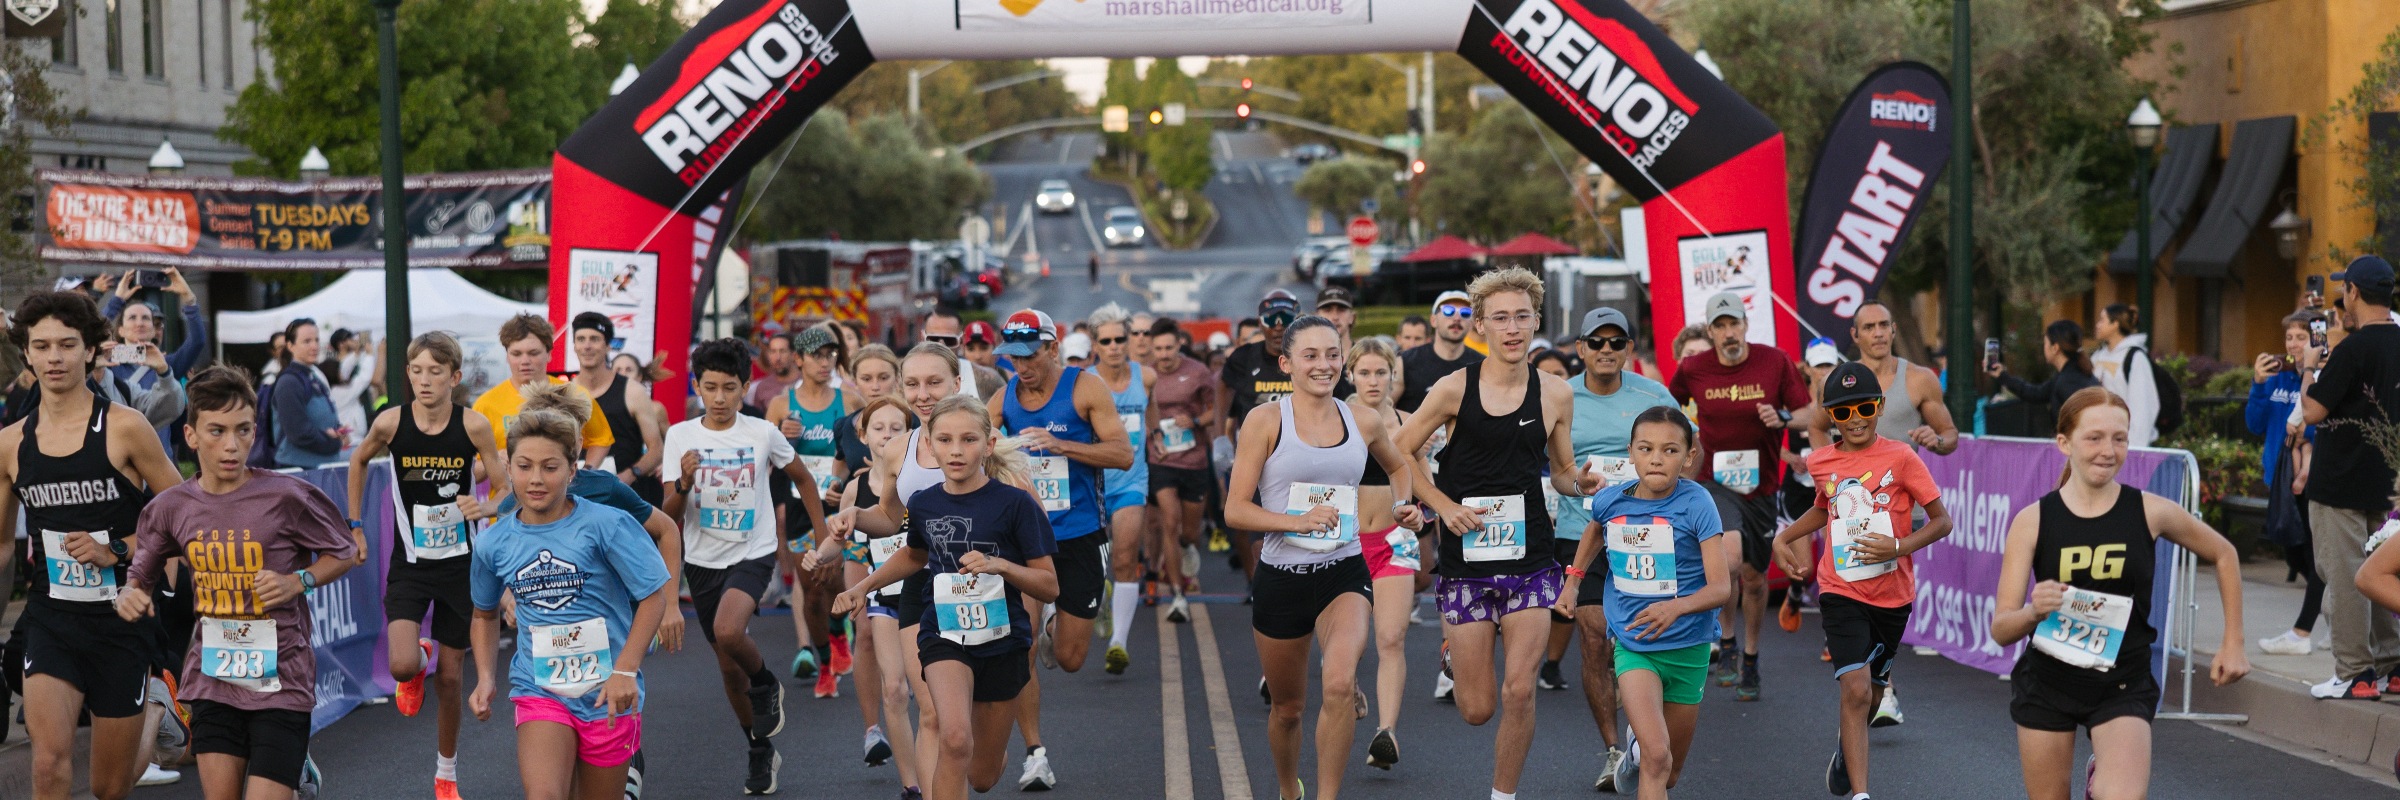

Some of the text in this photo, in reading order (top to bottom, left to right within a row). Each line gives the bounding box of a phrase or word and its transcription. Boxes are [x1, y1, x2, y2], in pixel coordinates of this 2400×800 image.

[778, 2, 840, 66] RACES
[1503, 0, 1669, 139] RENO
[641, 21, 803, 174] RENO
[1490, 31, 1638, 156] RUNNING CO
[678, 58, 822, 188] RUNNING CO
[1871, 98, 1930, 123] RENO
[1633, 109, 1690, 173] RACES
[56, 190, 187, 224] THEATRE PLAZA
[205, 198, 252, 216] Summer
[255, 203, 371, 227] TUESDAYS
[84, 218, 189, 248] TUESDAYS
[208, 217, 254, 233] Concert
[1807, 139, 1926, 319] START
[219, 232, 256, 250] Series
[257, 228, 333, 251] 7-9 PM
[580, 259, 615, 279] GOLD
[1692, 245, 1728, 267] GOLD
[1254, 380, 1294, 393] BUFFAL
[1704, 383, 1764, 400] OAK HILL
[402, 456, 465, 469] BUFFALO
[422, 468, 462, 481] CHIPS
[694, 468, 753, 489] USA
[1721, 468, 1752, 487] 232
[19, 476, 121, 509] PONDEROSA
[711, 509, 747, 531] 137
[196, 529, 251, 541] 2023
[423, 526, 459, 548] 325
[1473, 521, 1516, 548] 202
[187, 541, 265, 573] GOLD
[1625, 554, 1656, 580] 48
[2058, 543, 2128, 584] PG
[56, 560, 104, 588] 293
[514, 571, 584, 594] CROSS COUNTRY
[537, 588, 563, 598] FINALS
[955, 603, 988, 630] 89
[1935, 583, 1965, 648] see
[1965, 592, 2004, 657] yo
[2052, 615, 2110, 656] 326
[215, 649, 265, 679] 283
[547, 653, 602, 685] 282
